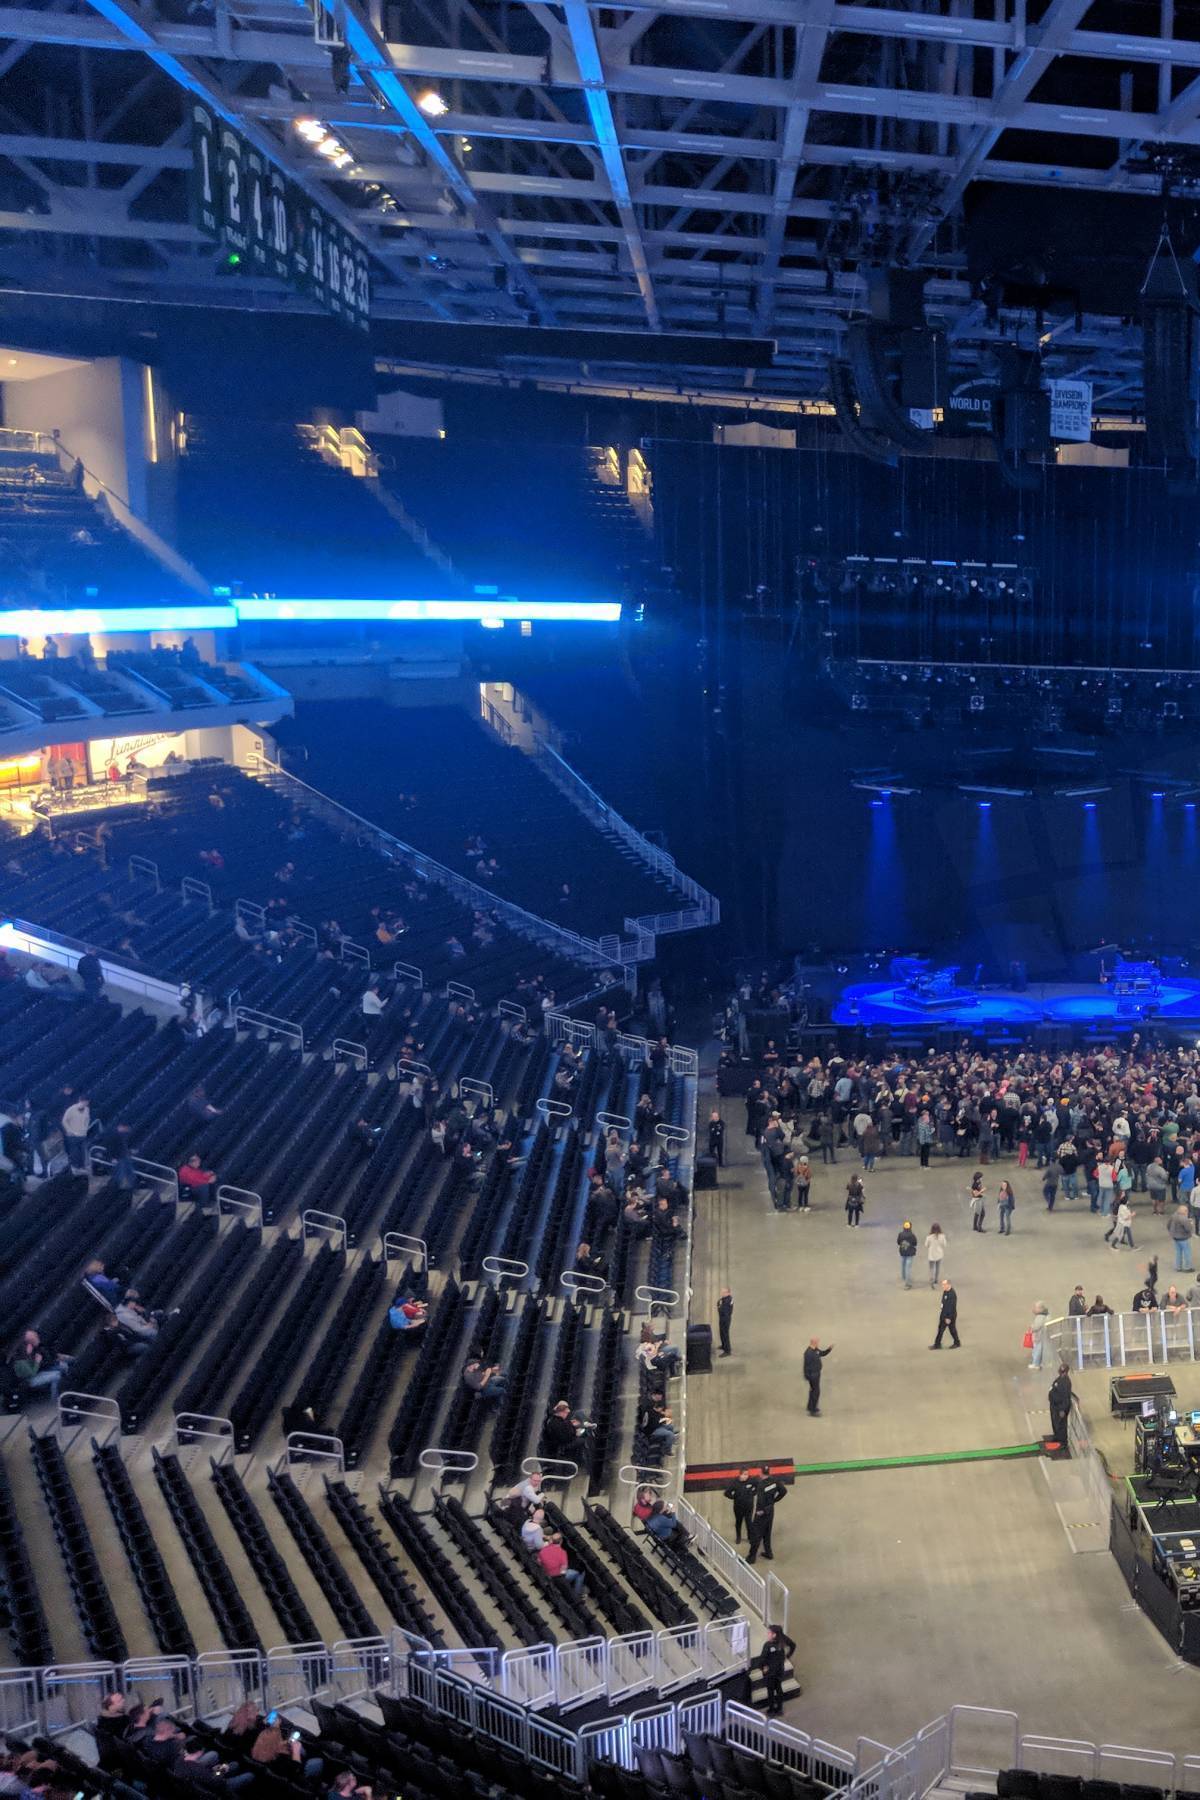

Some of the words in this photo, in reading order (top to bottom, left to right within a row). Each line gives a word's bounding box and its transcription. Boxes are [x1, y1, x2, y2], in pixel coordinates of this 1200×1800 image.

[228, 159, 241, 223] 2
[273, 195, 288, 255] 10
[950, 397, 980, 410] WORLD
[1055, 389, 1083, 400] DIVISION
